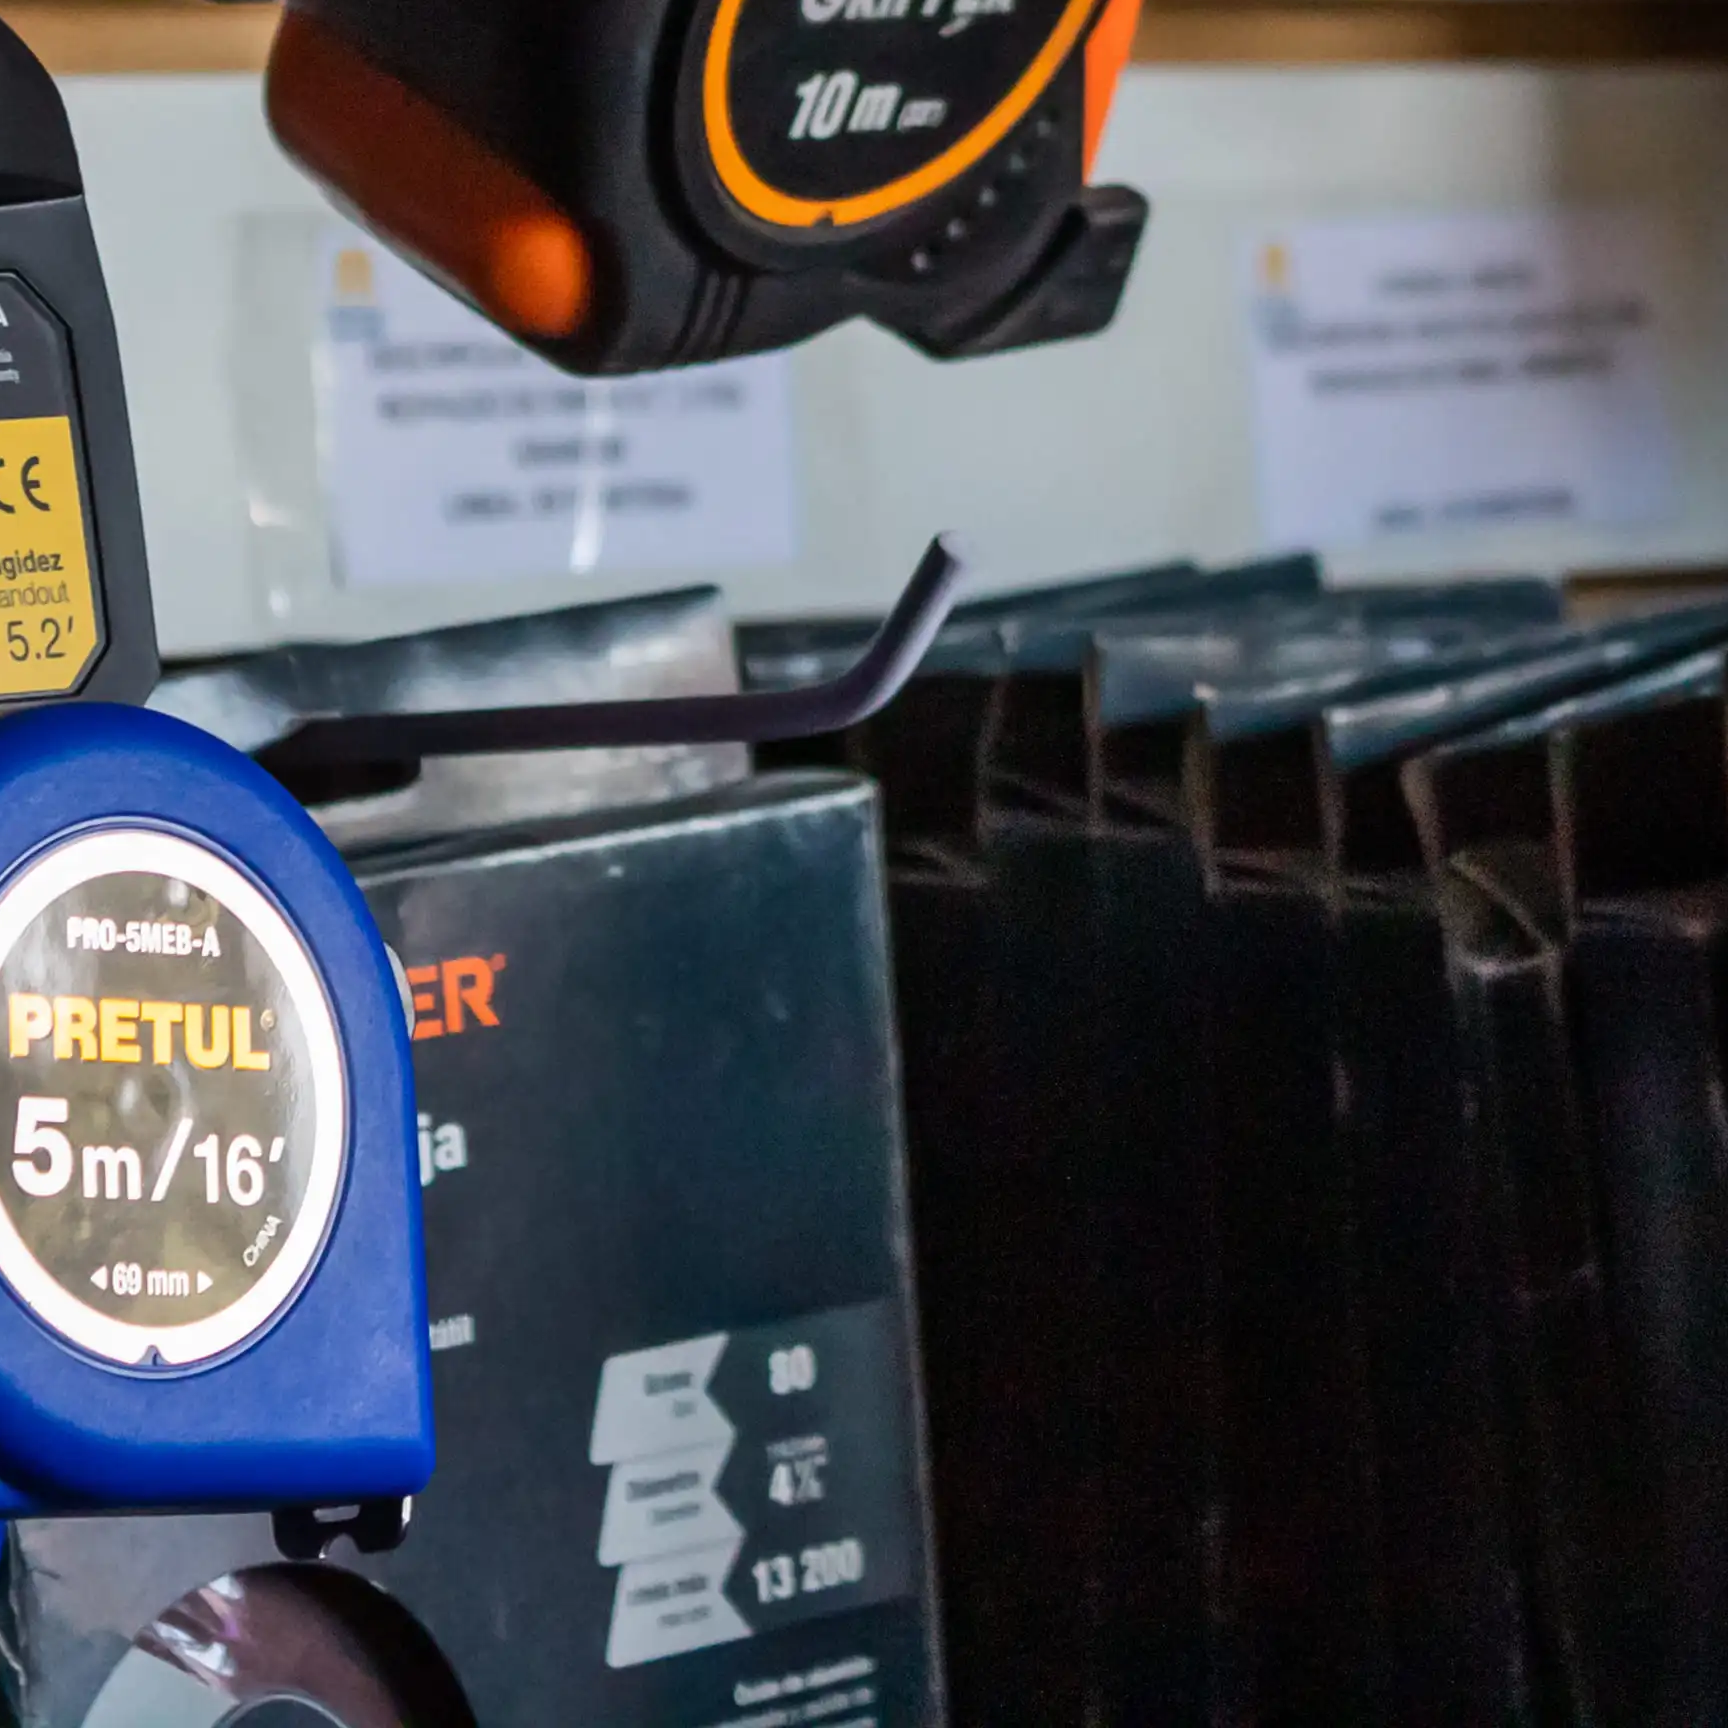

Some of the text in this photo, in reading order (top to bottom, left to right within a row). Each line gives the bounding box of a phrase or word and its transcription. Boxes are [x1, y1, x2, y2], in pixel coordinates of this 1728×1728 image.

[788, 69, 859, 140] 10
[7, 614, 74, 662] 5.2'
[66, 916, 221, 958] PRO-5MEB-A
[8, 992, 271, 1071] PRETUL
[112, 1262, 190, 1297] 69 mm
[752, 1555, 795, 1603] 13
